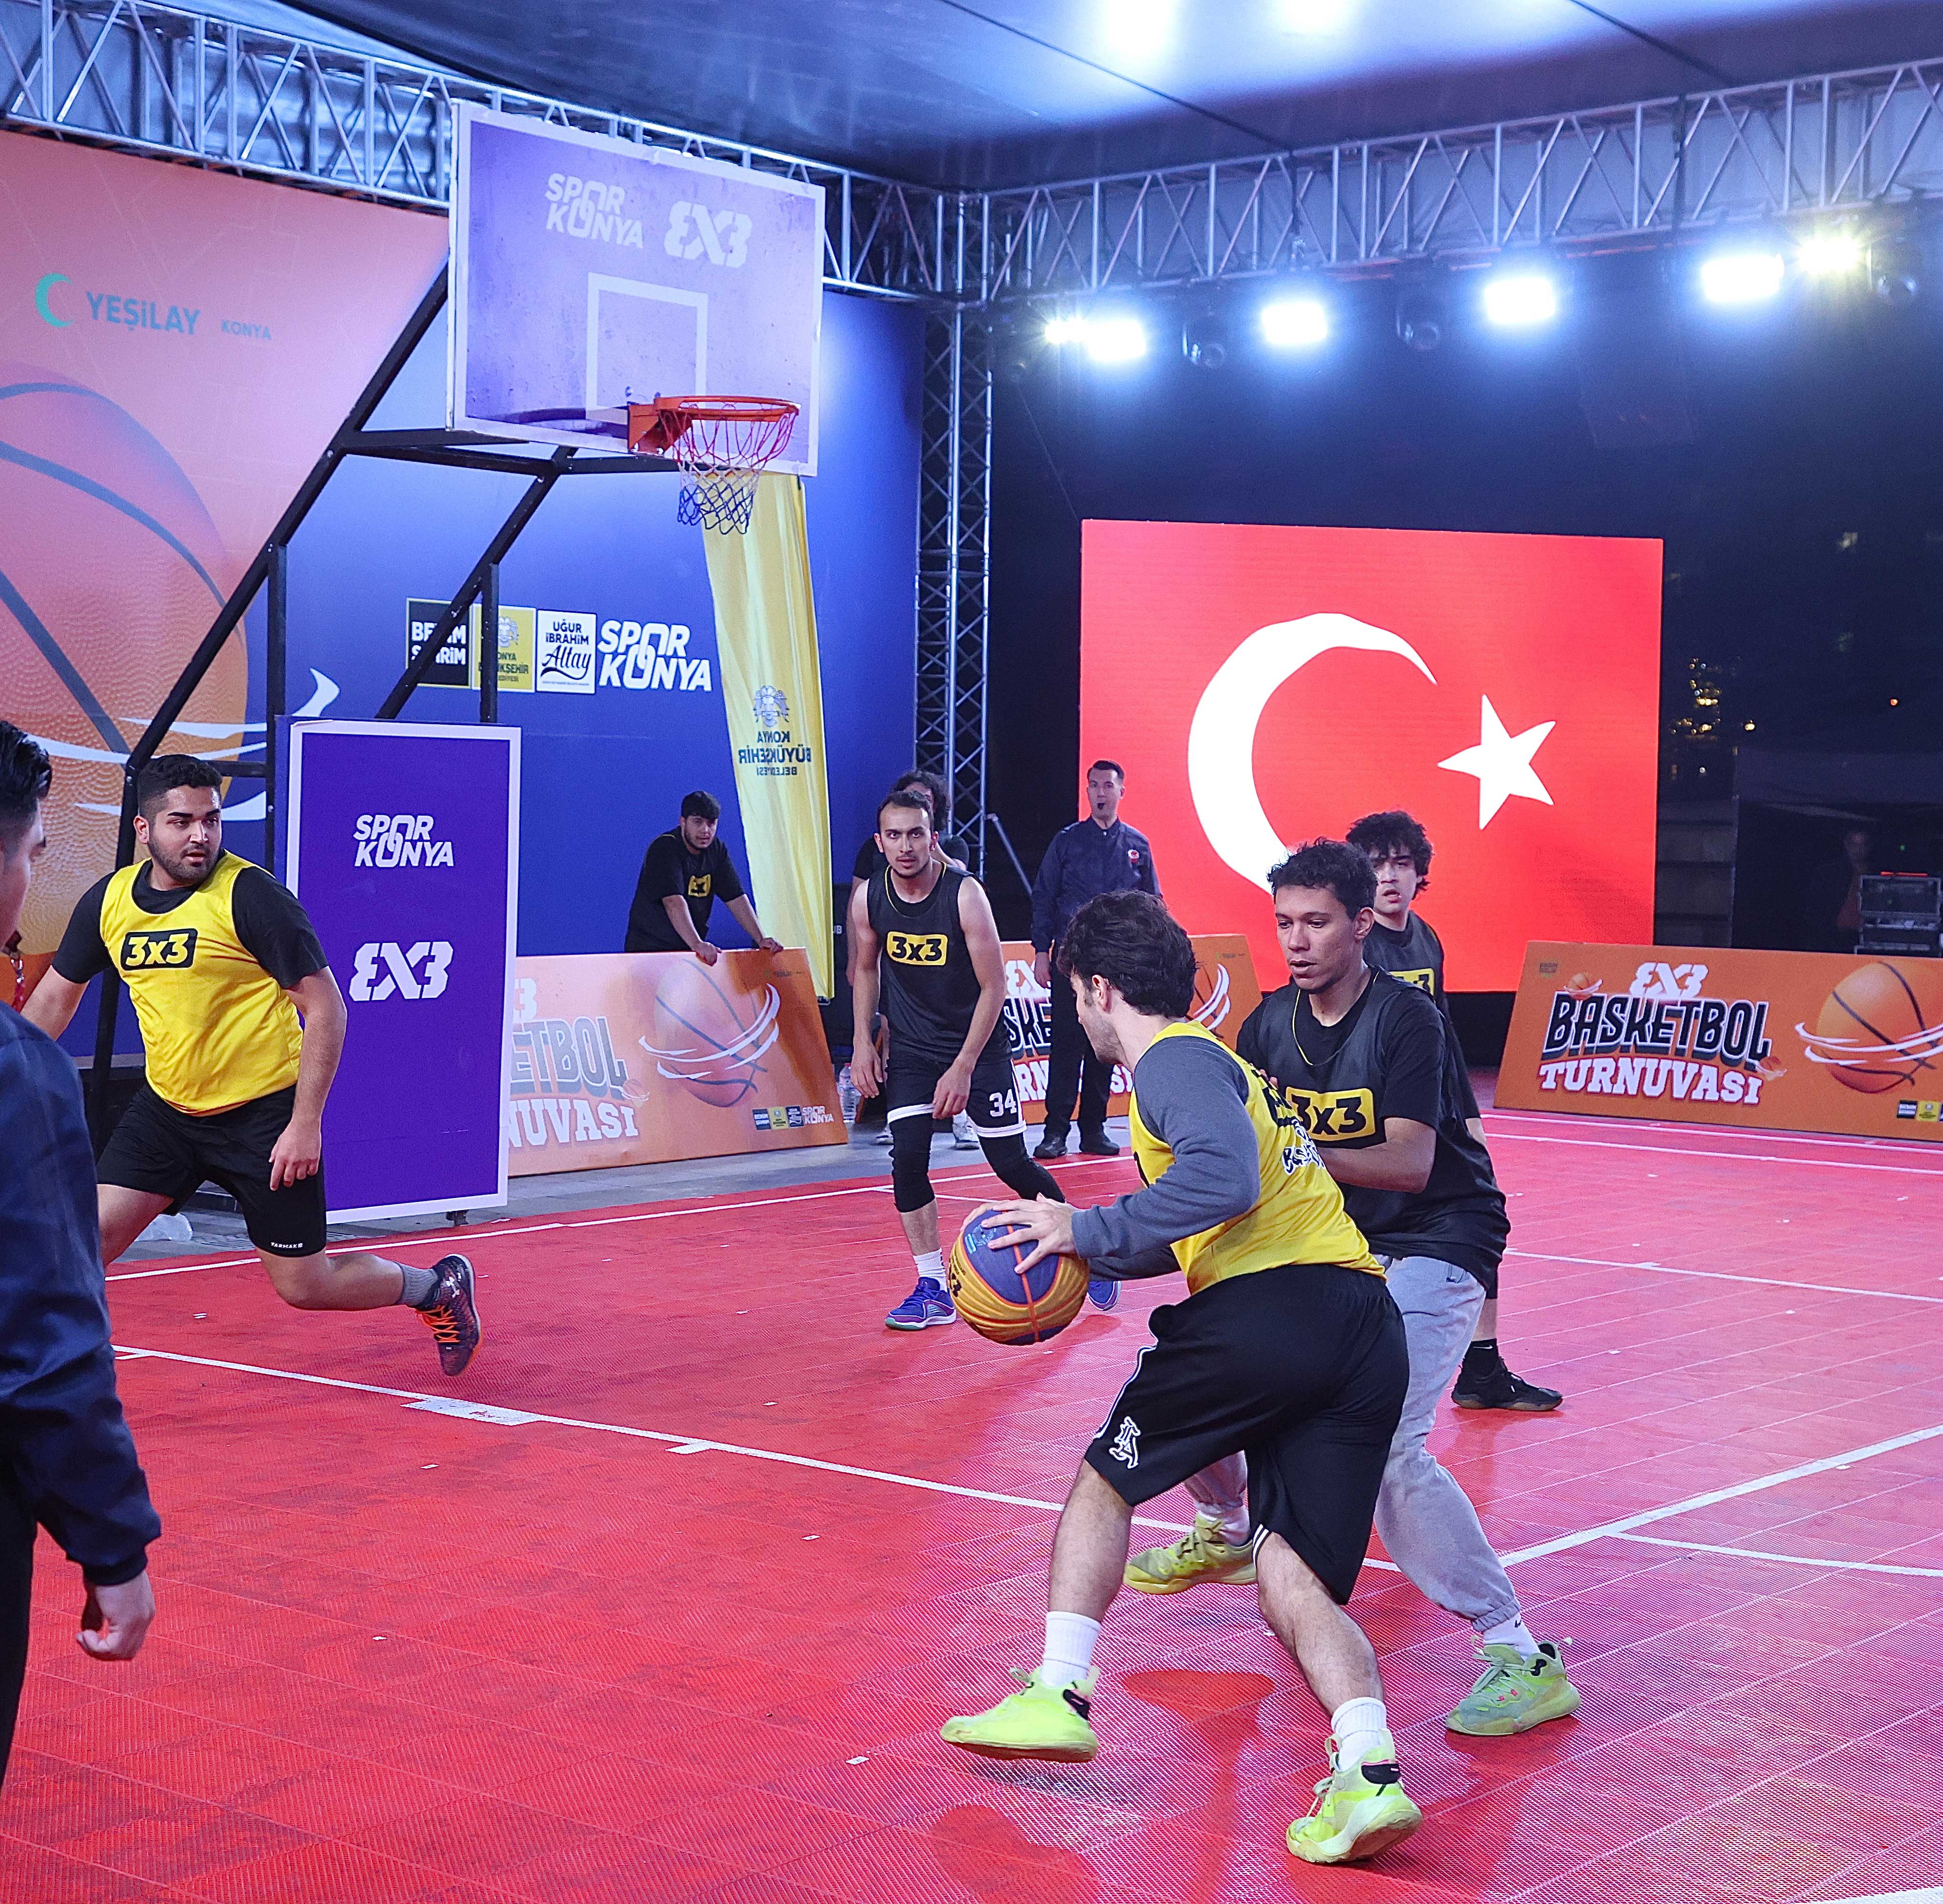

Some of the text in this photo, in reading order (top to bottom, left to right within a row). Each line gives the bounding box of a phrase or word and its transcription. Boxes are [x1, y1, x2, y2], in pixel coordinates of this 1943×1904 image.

[545, 172, 626, 218] SPOR
[546, 198, 643, 248] KONYA
[86, 291, 272, 339] YEŞİLAY KONYA
[553, 619, 582, 633] UĞUR
[598, 620, 691, 668] SPOR
[599, 644, 712, 692] KONYA
[353, 814, 434, 851] SPOR
[354, 832, 454, 867] KONYA
[125, 933, 189, 966] 3x3
[891, 936, 943, 962] 3x3
[1541, 991, 1773, 1073] BASKETBOL
[510, 1016, 629, 1101] ETBOL
[1539, 1057, 1763, 1104] TURNUVASI
[989, 1089, 1017, 1117] 34
